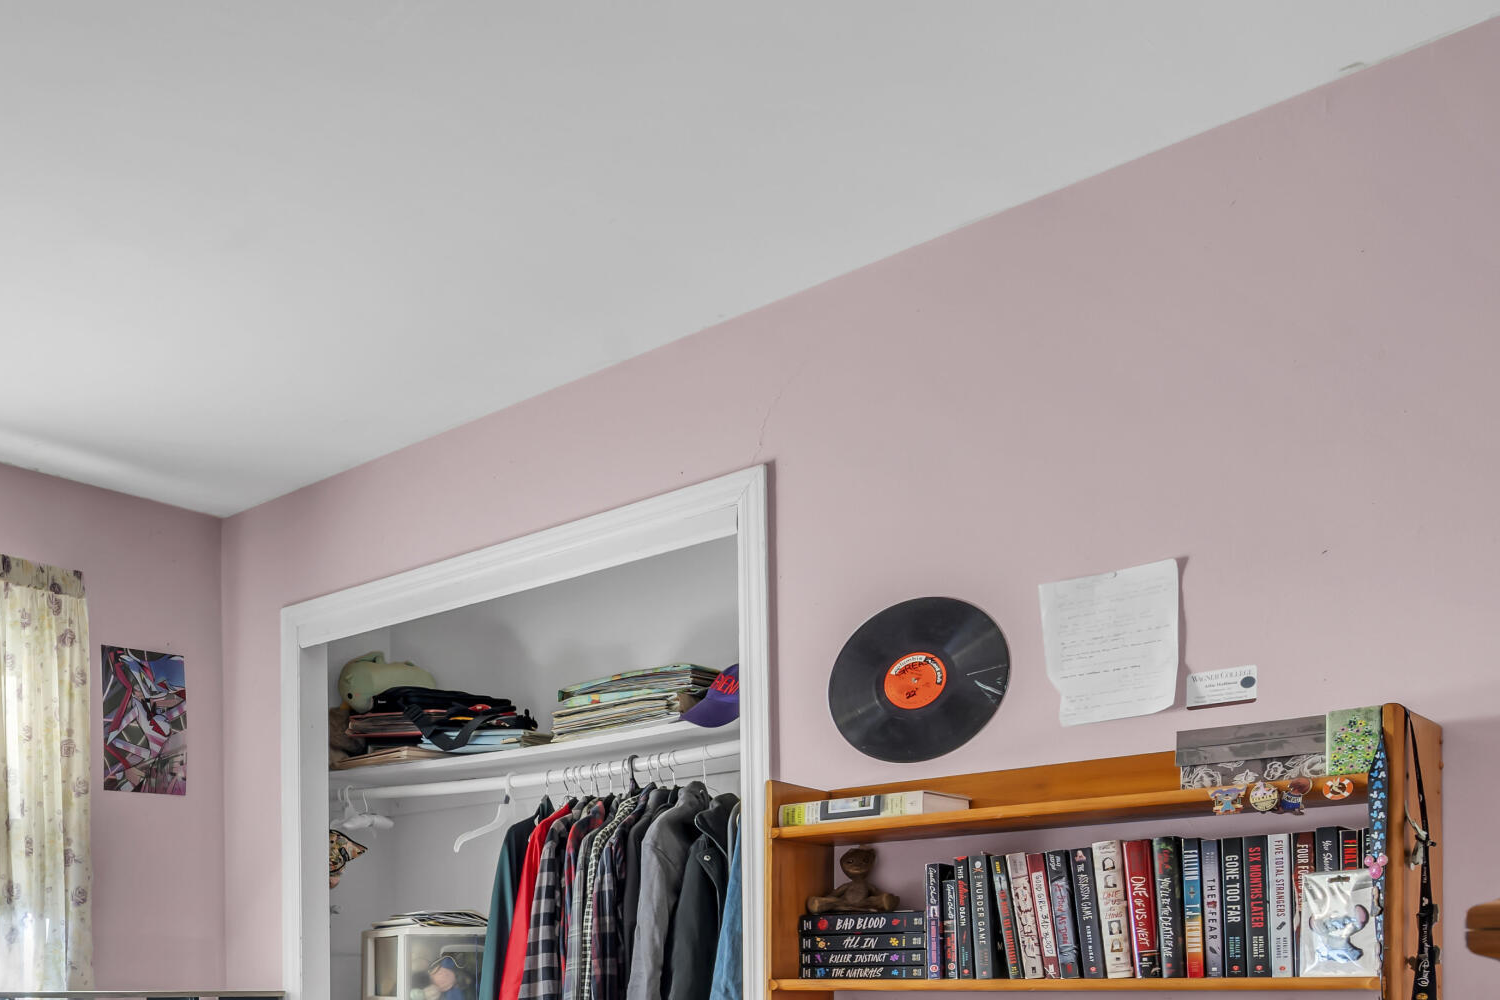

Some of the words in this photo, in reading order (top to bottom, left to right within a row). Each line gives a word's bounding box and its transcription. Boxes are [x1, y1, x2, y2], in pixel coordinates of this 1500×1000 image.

[1249, 846, 1260, 862] SIX
[1274, 840, 1283, 855] FIVE
[1297, 844, 1308, 863] FOUR
[1344, 840, 1357, 864] FINAL
[1076, 863, 1084, 872] THE
[1225, 855, 1239, 880] GONE
[1275, 857, 1284, 877] TOTAL
[1077, 874, 1090, 900] ASSASSIN
[1131, 876, 1149, 897] ONE
[1207, 879, 1216, 899] THE
[1226, 883, 1240, 901] TOO
[1249, 865, 1262, 899] MONTHS
[975, 881, 985, 918] MURDER
[1134, 898, 1146, 908] OF
[1276, 878, 1286, 918] STRANGERS
[1081, 900, 1093, 921] GAME
[1135, 909, 1147, 920] US
[1227, 904, 1241, 923] FAR
[1250, 901, 1264, 928] LATER
[836, 918, 854, 930] BAD
[856, 917, 887, 929] BLOOD
[977, 921, 986, 945] GAME
[1160, 916, 1173, 940] DEATH
[1208, 910, 1217, 940] FEAR
[843, 938, 860, 948] ALL
[861, 937, 879, 948] IN
[1136, 927, 1150, 947] NEXT
[829, 954, 852, 963] KILLER
[852, 953, 889, 963] INSTINCT
[1163, 946, 1173, 958] ME
[831, 968, 846, 977] THE
[846, 967, 883, 977] NATURALS
